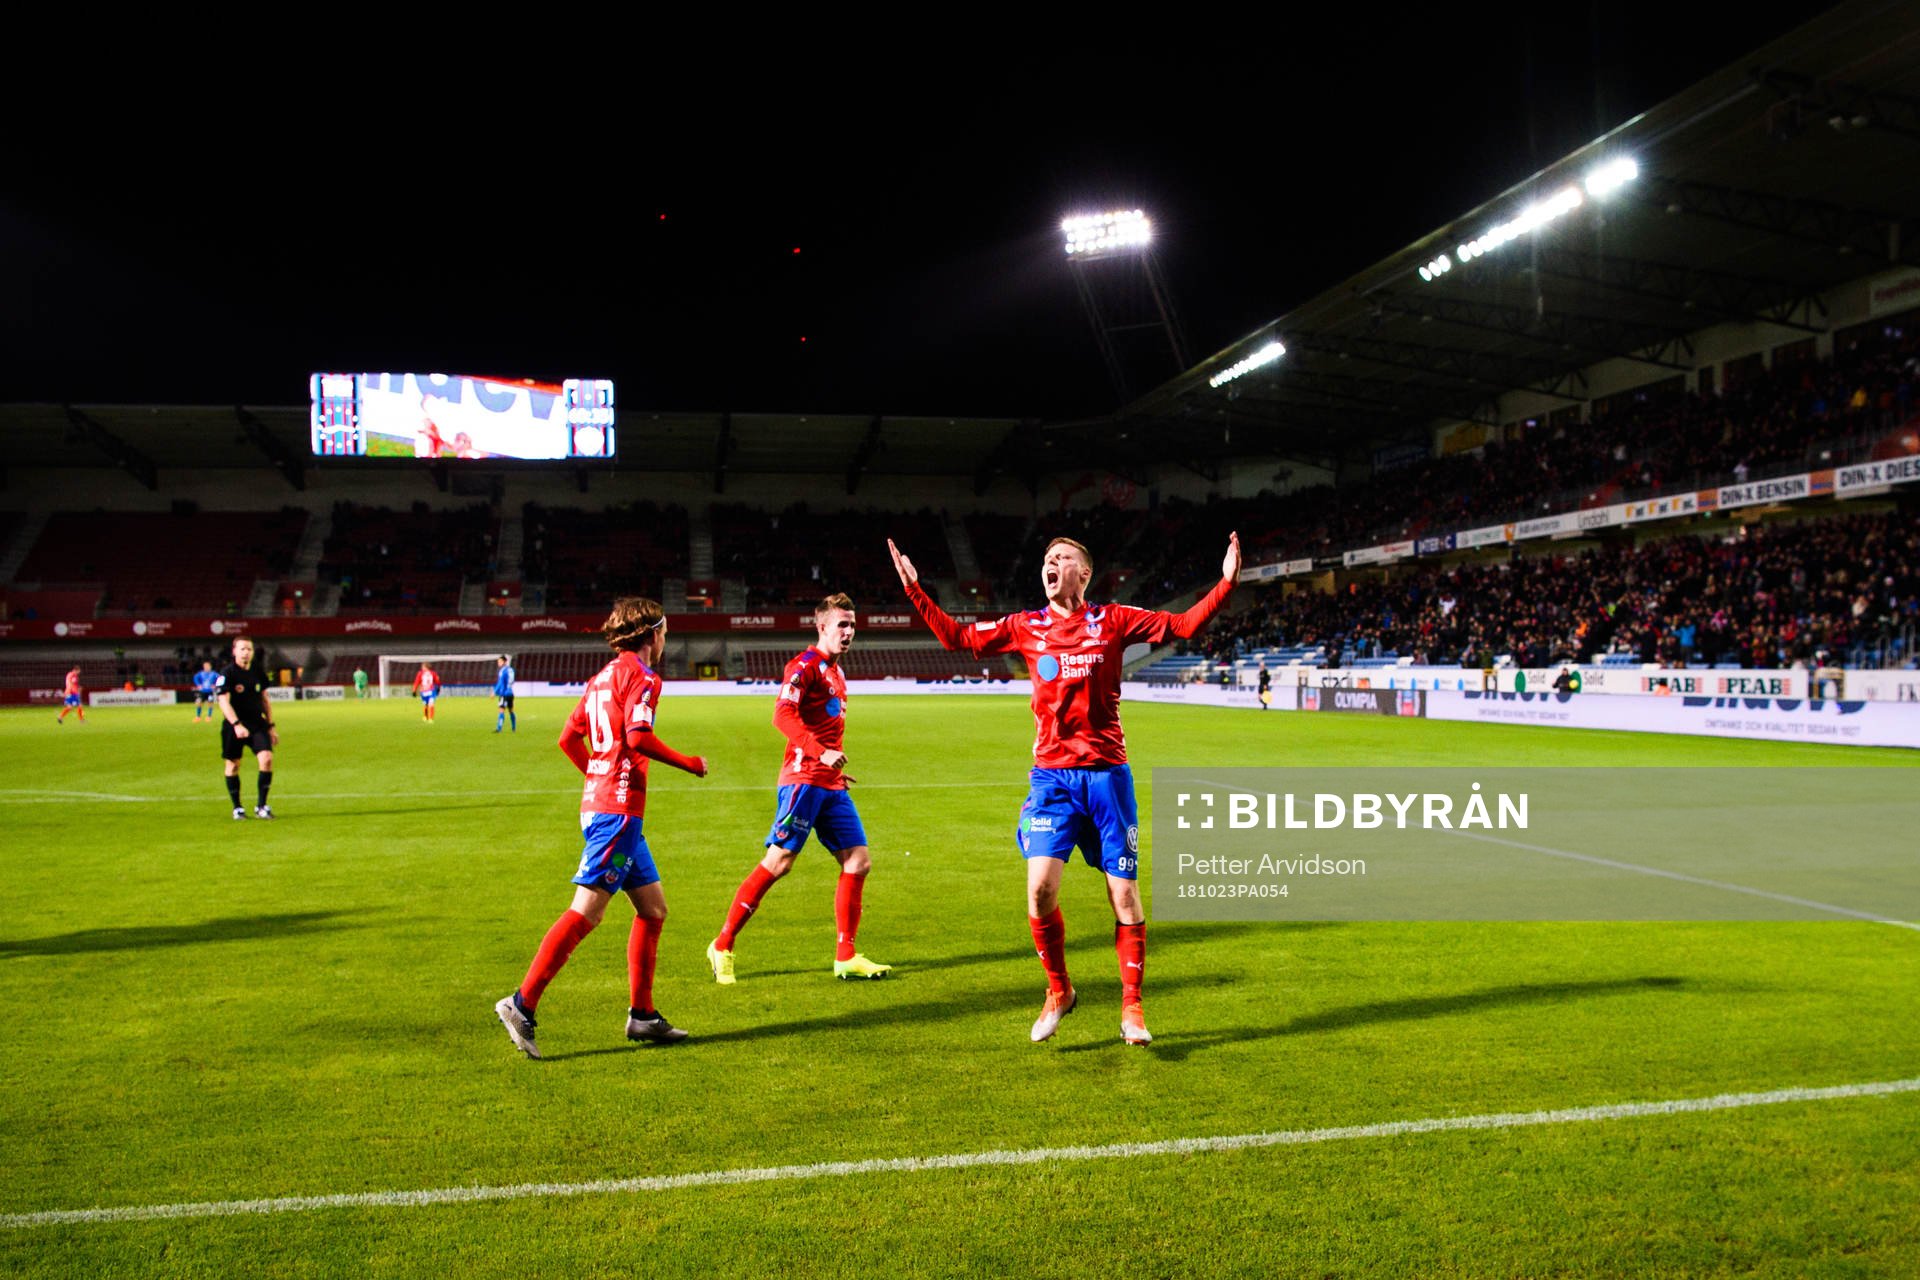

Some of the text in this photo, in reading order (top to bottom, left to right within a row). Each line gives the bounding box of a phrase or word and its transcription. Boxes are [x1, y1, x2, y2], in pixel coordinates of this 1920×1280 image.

[1840, 467, 1882, 487] DIN-X
[1720, 478, 1806, 505] DIN-X BENSIN
[1060, 652, 1105, 666] Resurs
[1061, 664, 1093, 679] Bank
[1647, 676, 1697, 693] PAB
[1726, 677, 1784, 696] PEAB
[1334, 691, 1379, 711] OLYMPIA
[584, 689, 614, 753] 15
[1030, 816, 1053, 826] Solid
